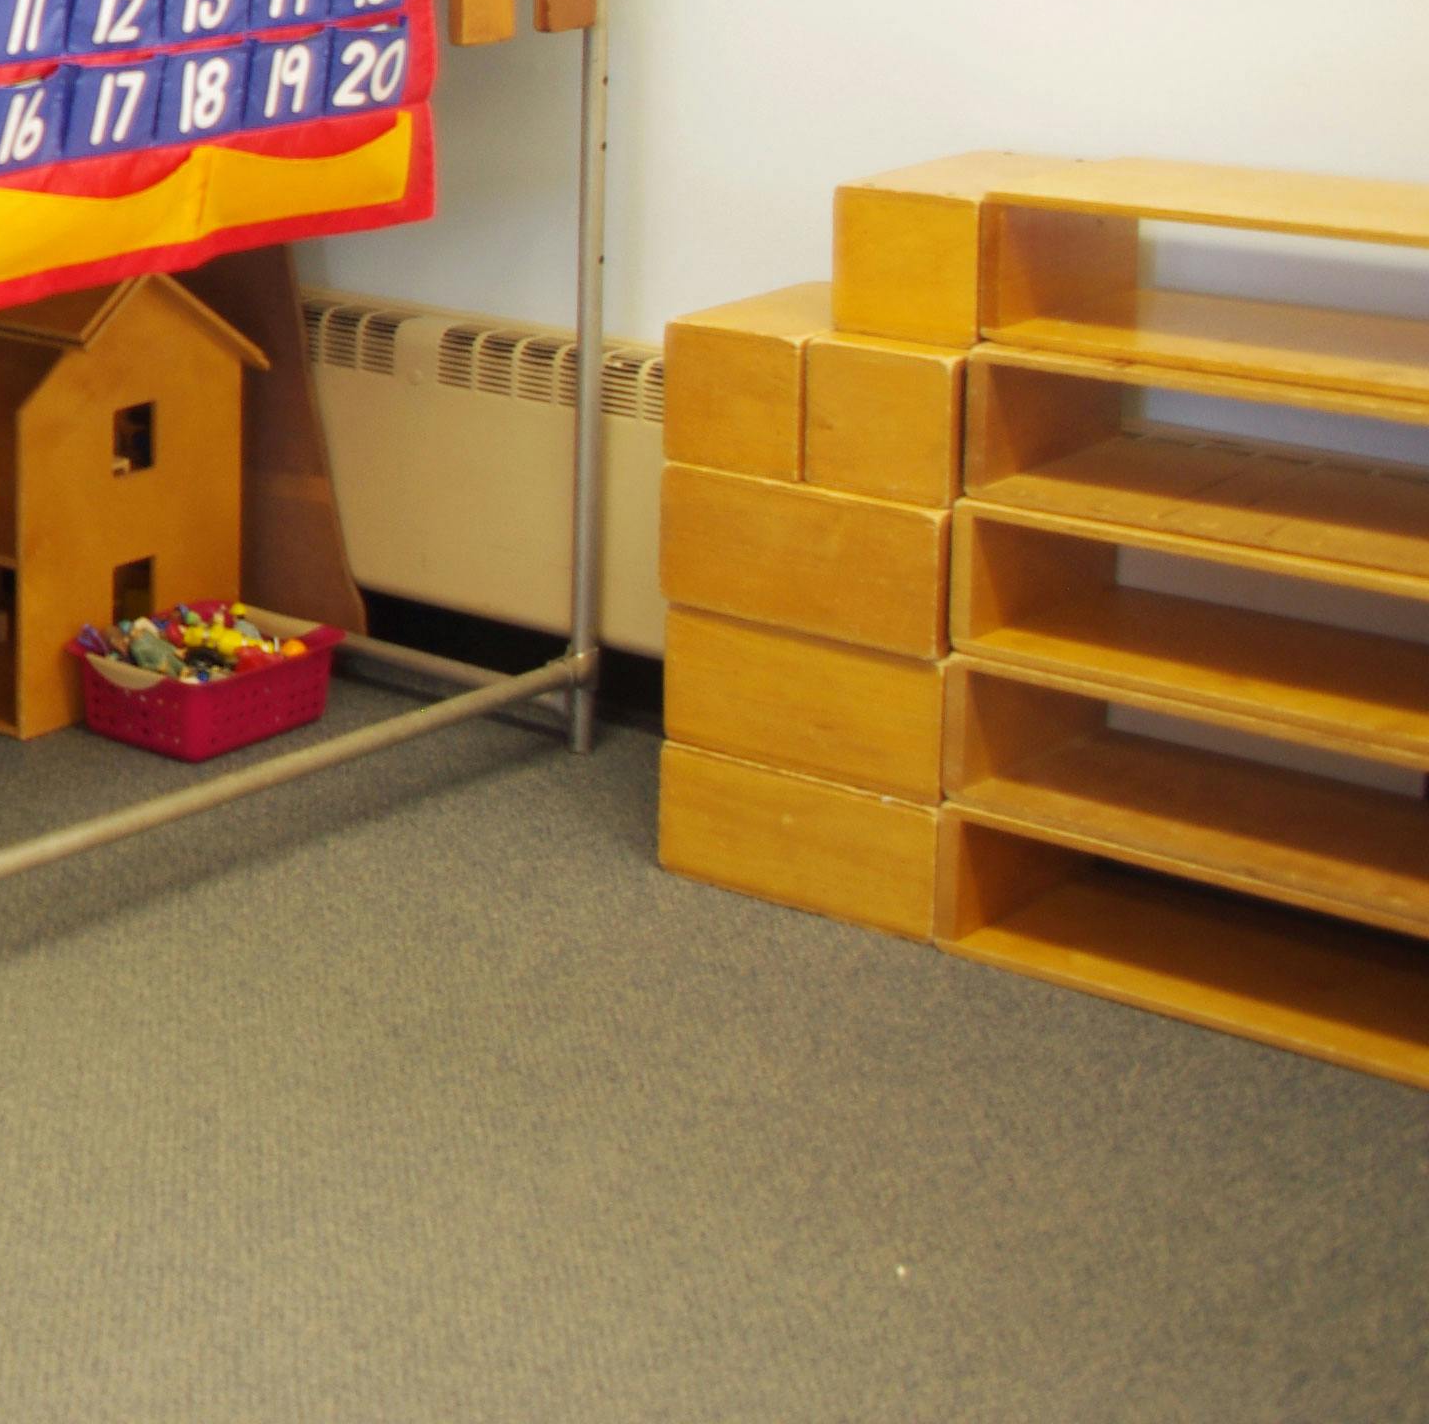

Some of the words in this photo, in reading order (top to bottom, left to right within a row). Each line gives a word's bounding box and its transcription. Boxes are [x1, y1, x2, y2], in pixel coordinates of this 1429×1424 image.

[90, 70, 146, 145] 17
[179, 57, 230, 133] 18
[264, 44, 311, 118] 19
[333, 39, 406, 107] 20
